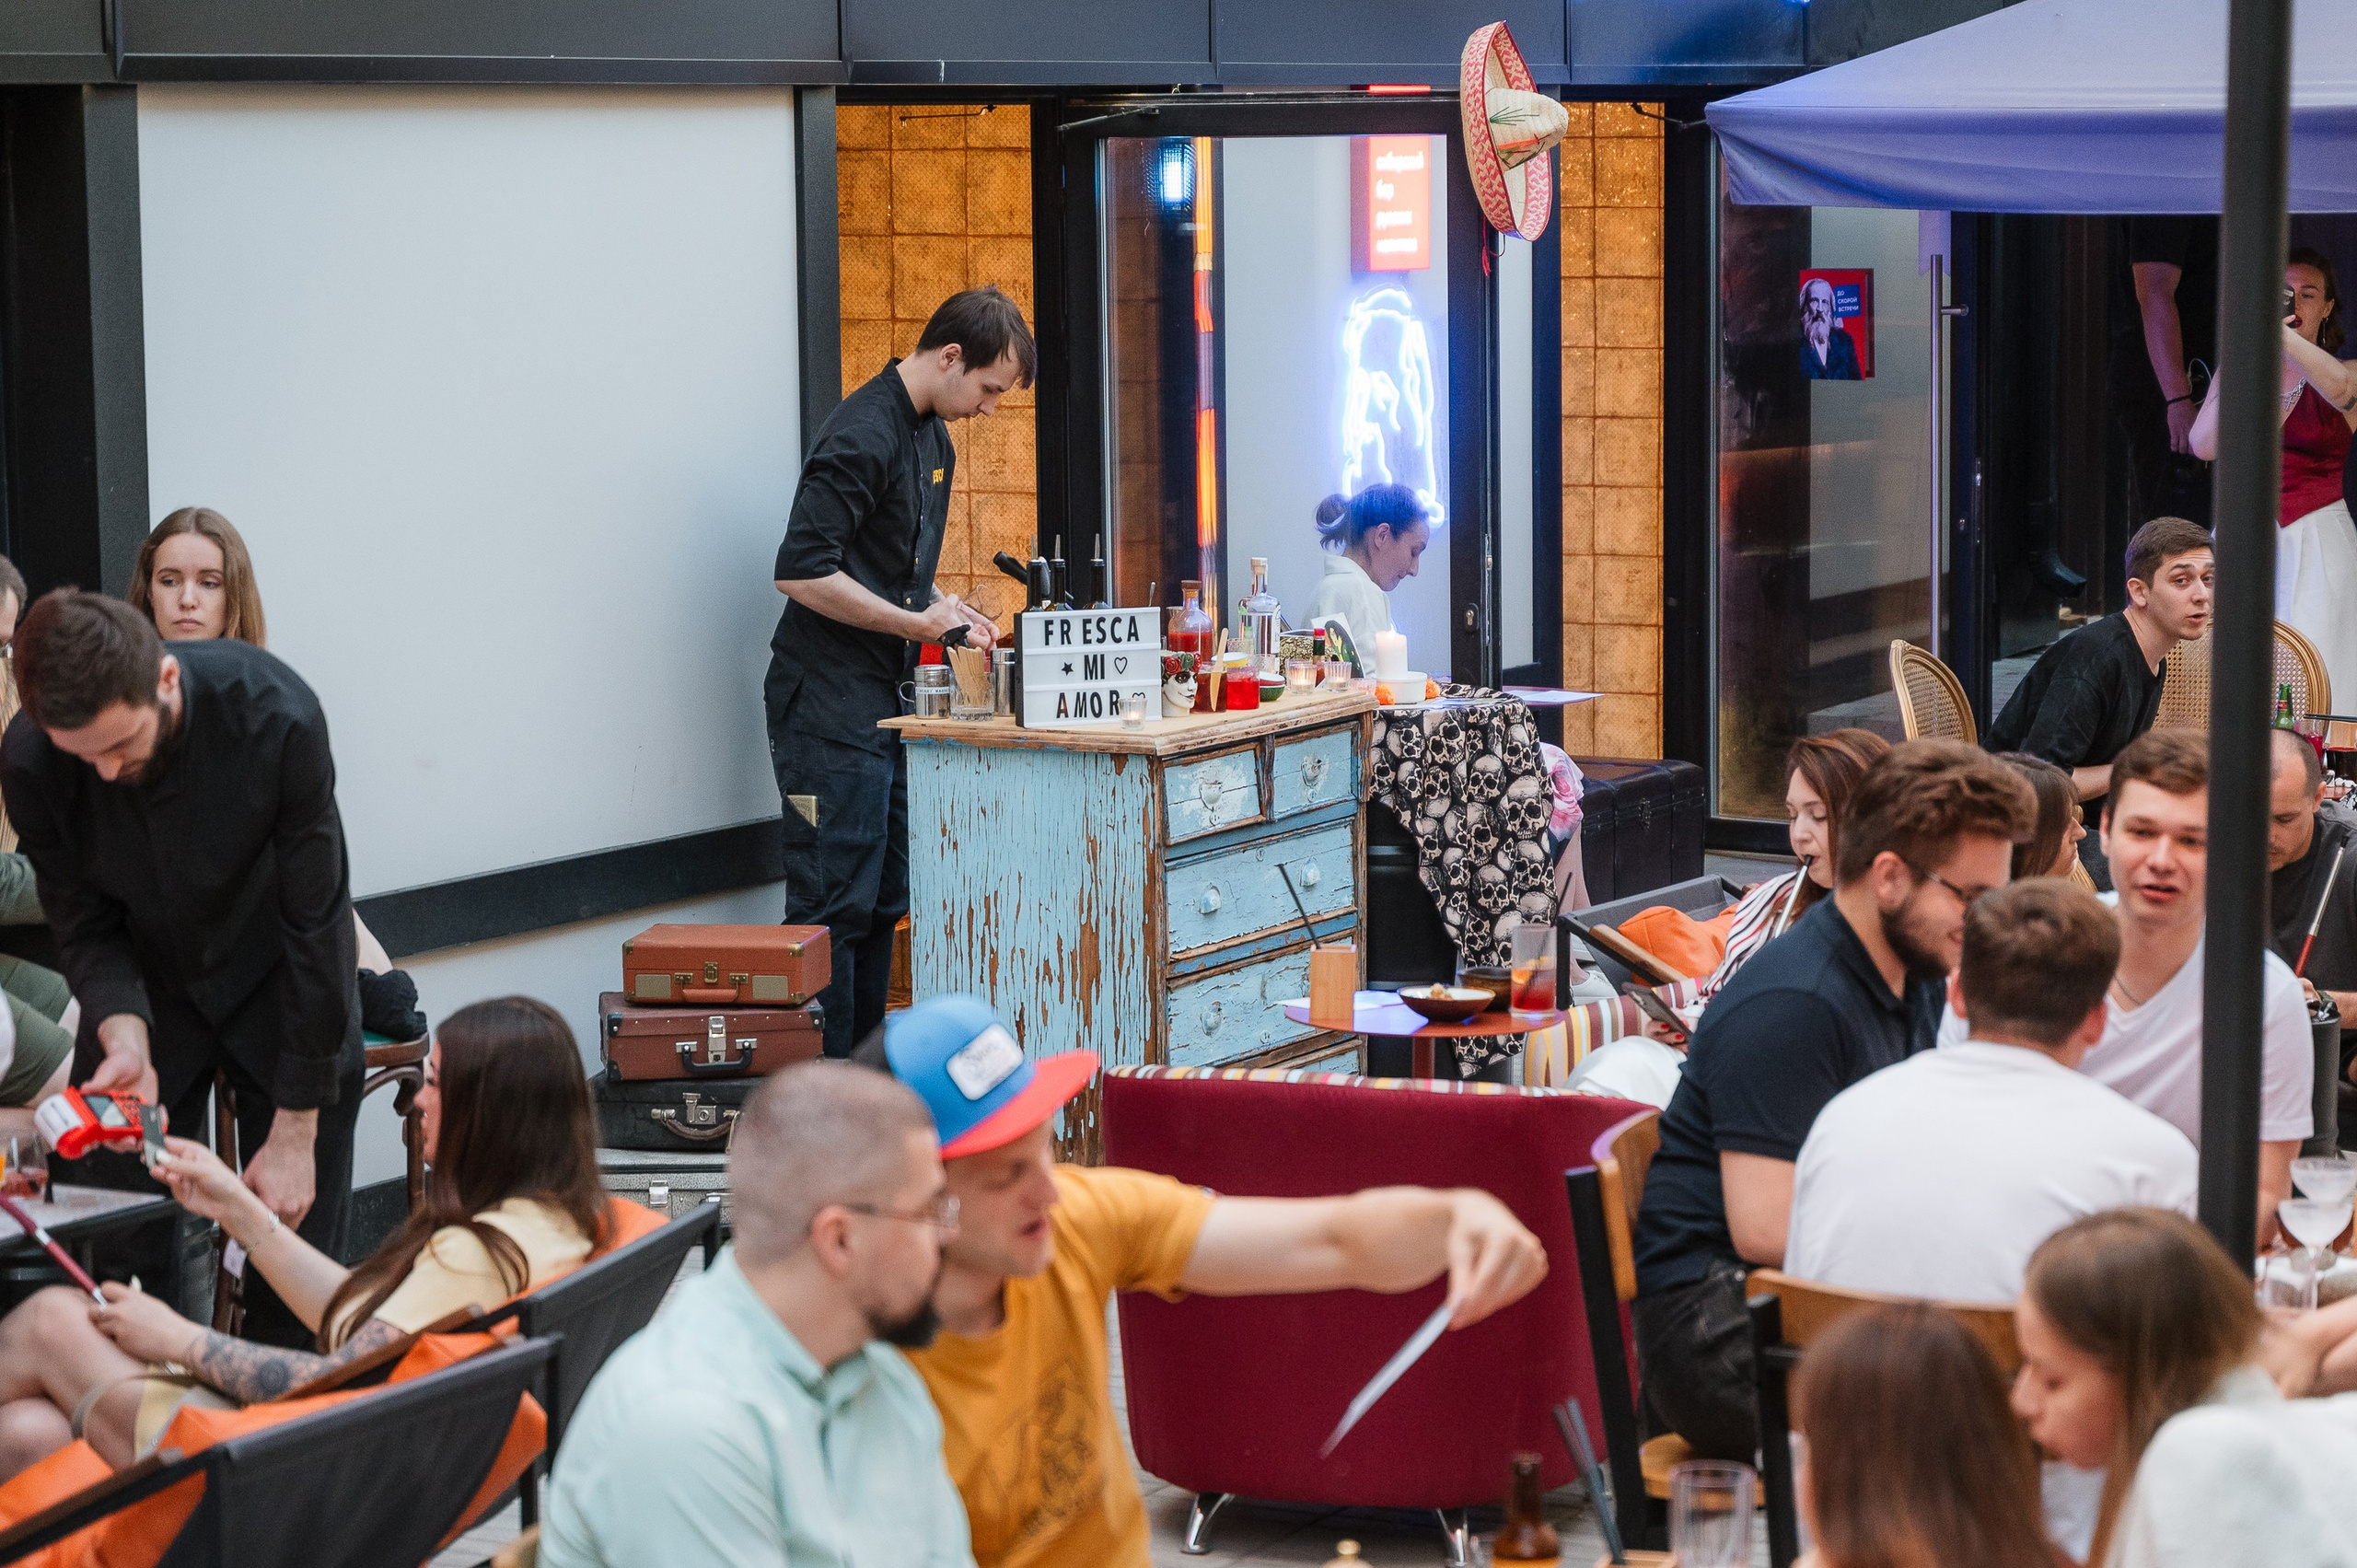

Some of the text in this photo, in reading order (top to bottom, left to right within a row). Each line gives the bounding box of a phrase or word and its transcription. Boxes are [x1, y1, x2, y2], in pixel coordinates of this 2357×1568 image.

[1043, 615, 1140, 646] FRESCA
[1084, 654, 1106, 681] MI
[1055, 689, 1120, 719] AMOR
